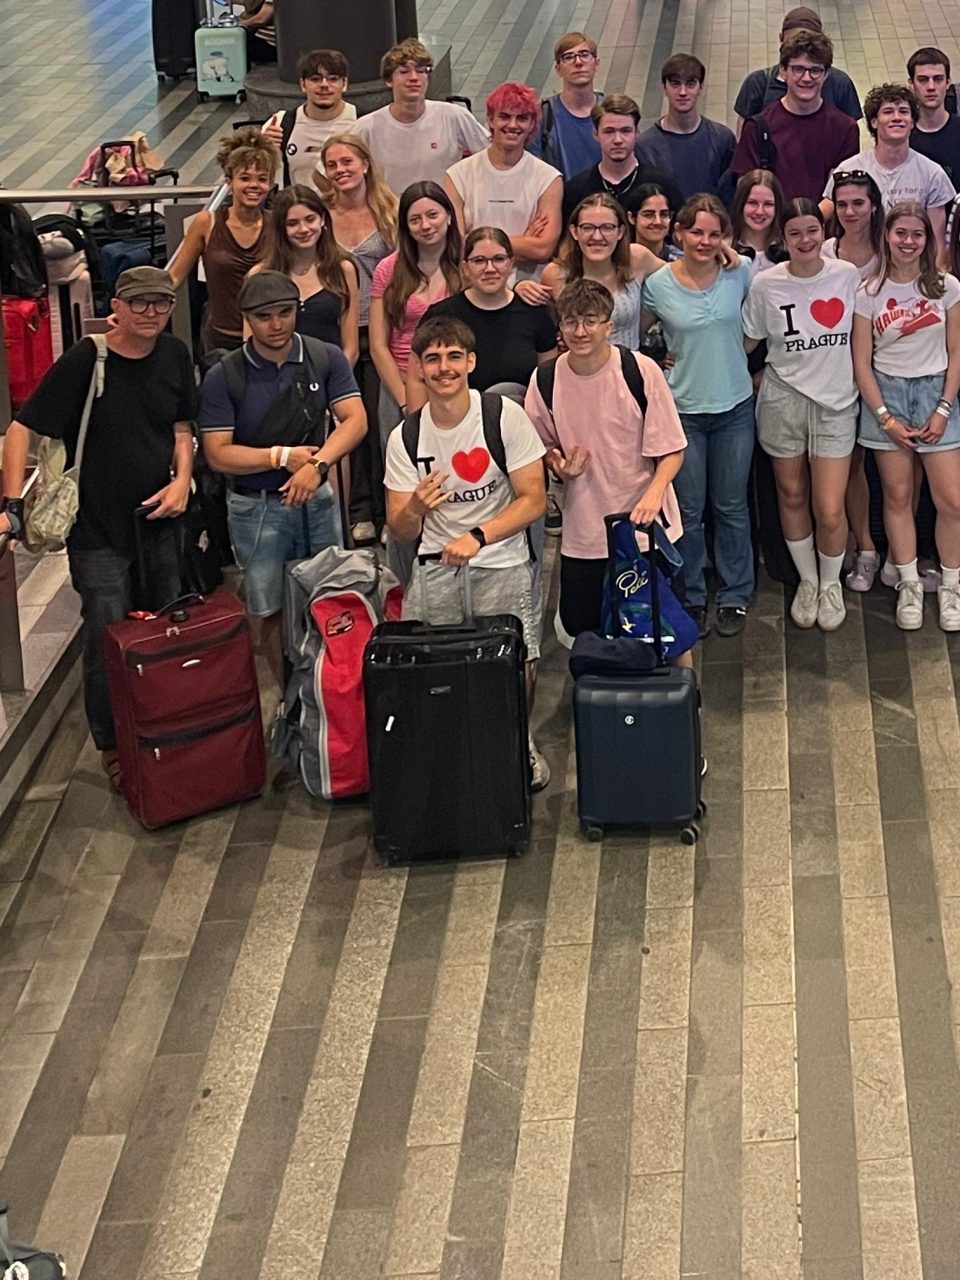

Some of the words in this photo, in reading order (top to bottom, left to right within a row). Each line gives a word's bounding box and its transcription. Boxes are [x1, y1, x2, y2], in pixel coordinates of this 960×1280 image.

[779, 304, 800, 337] I
[784, 332, 848, 352] PRAGUE
[445, 479, 497, 503] AGUE
